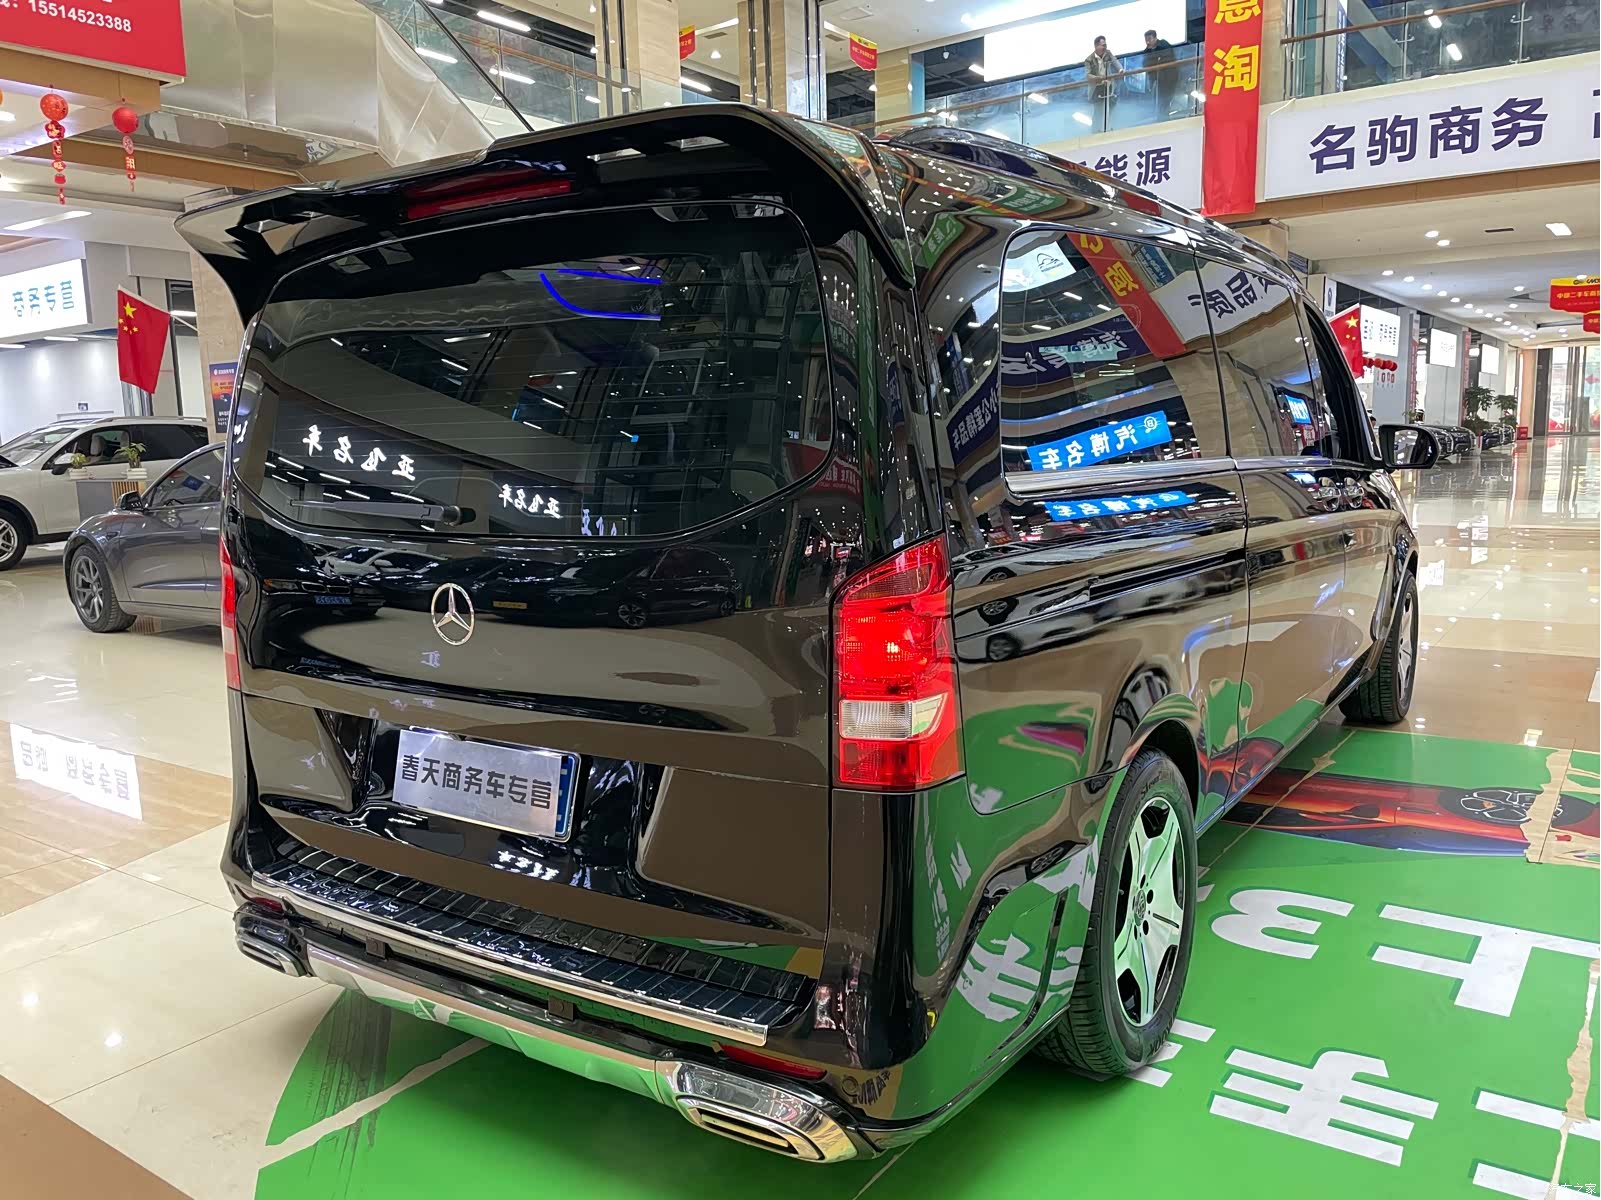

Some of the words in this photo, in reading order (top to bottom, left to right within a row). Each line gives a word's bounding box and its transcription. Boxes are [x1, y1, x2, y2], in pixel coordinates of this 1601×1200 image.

[28, 0, 132, 32] 15514523388
[1309, 98, 1548, 174] 名驹商务
[1079, 146, 1171, 187] 能源
[12, 280, 74, 317] 商务专营
[401, 754, 552, 810] 春天商务车专营
[1197, 866, 1600, 1017] 上3
